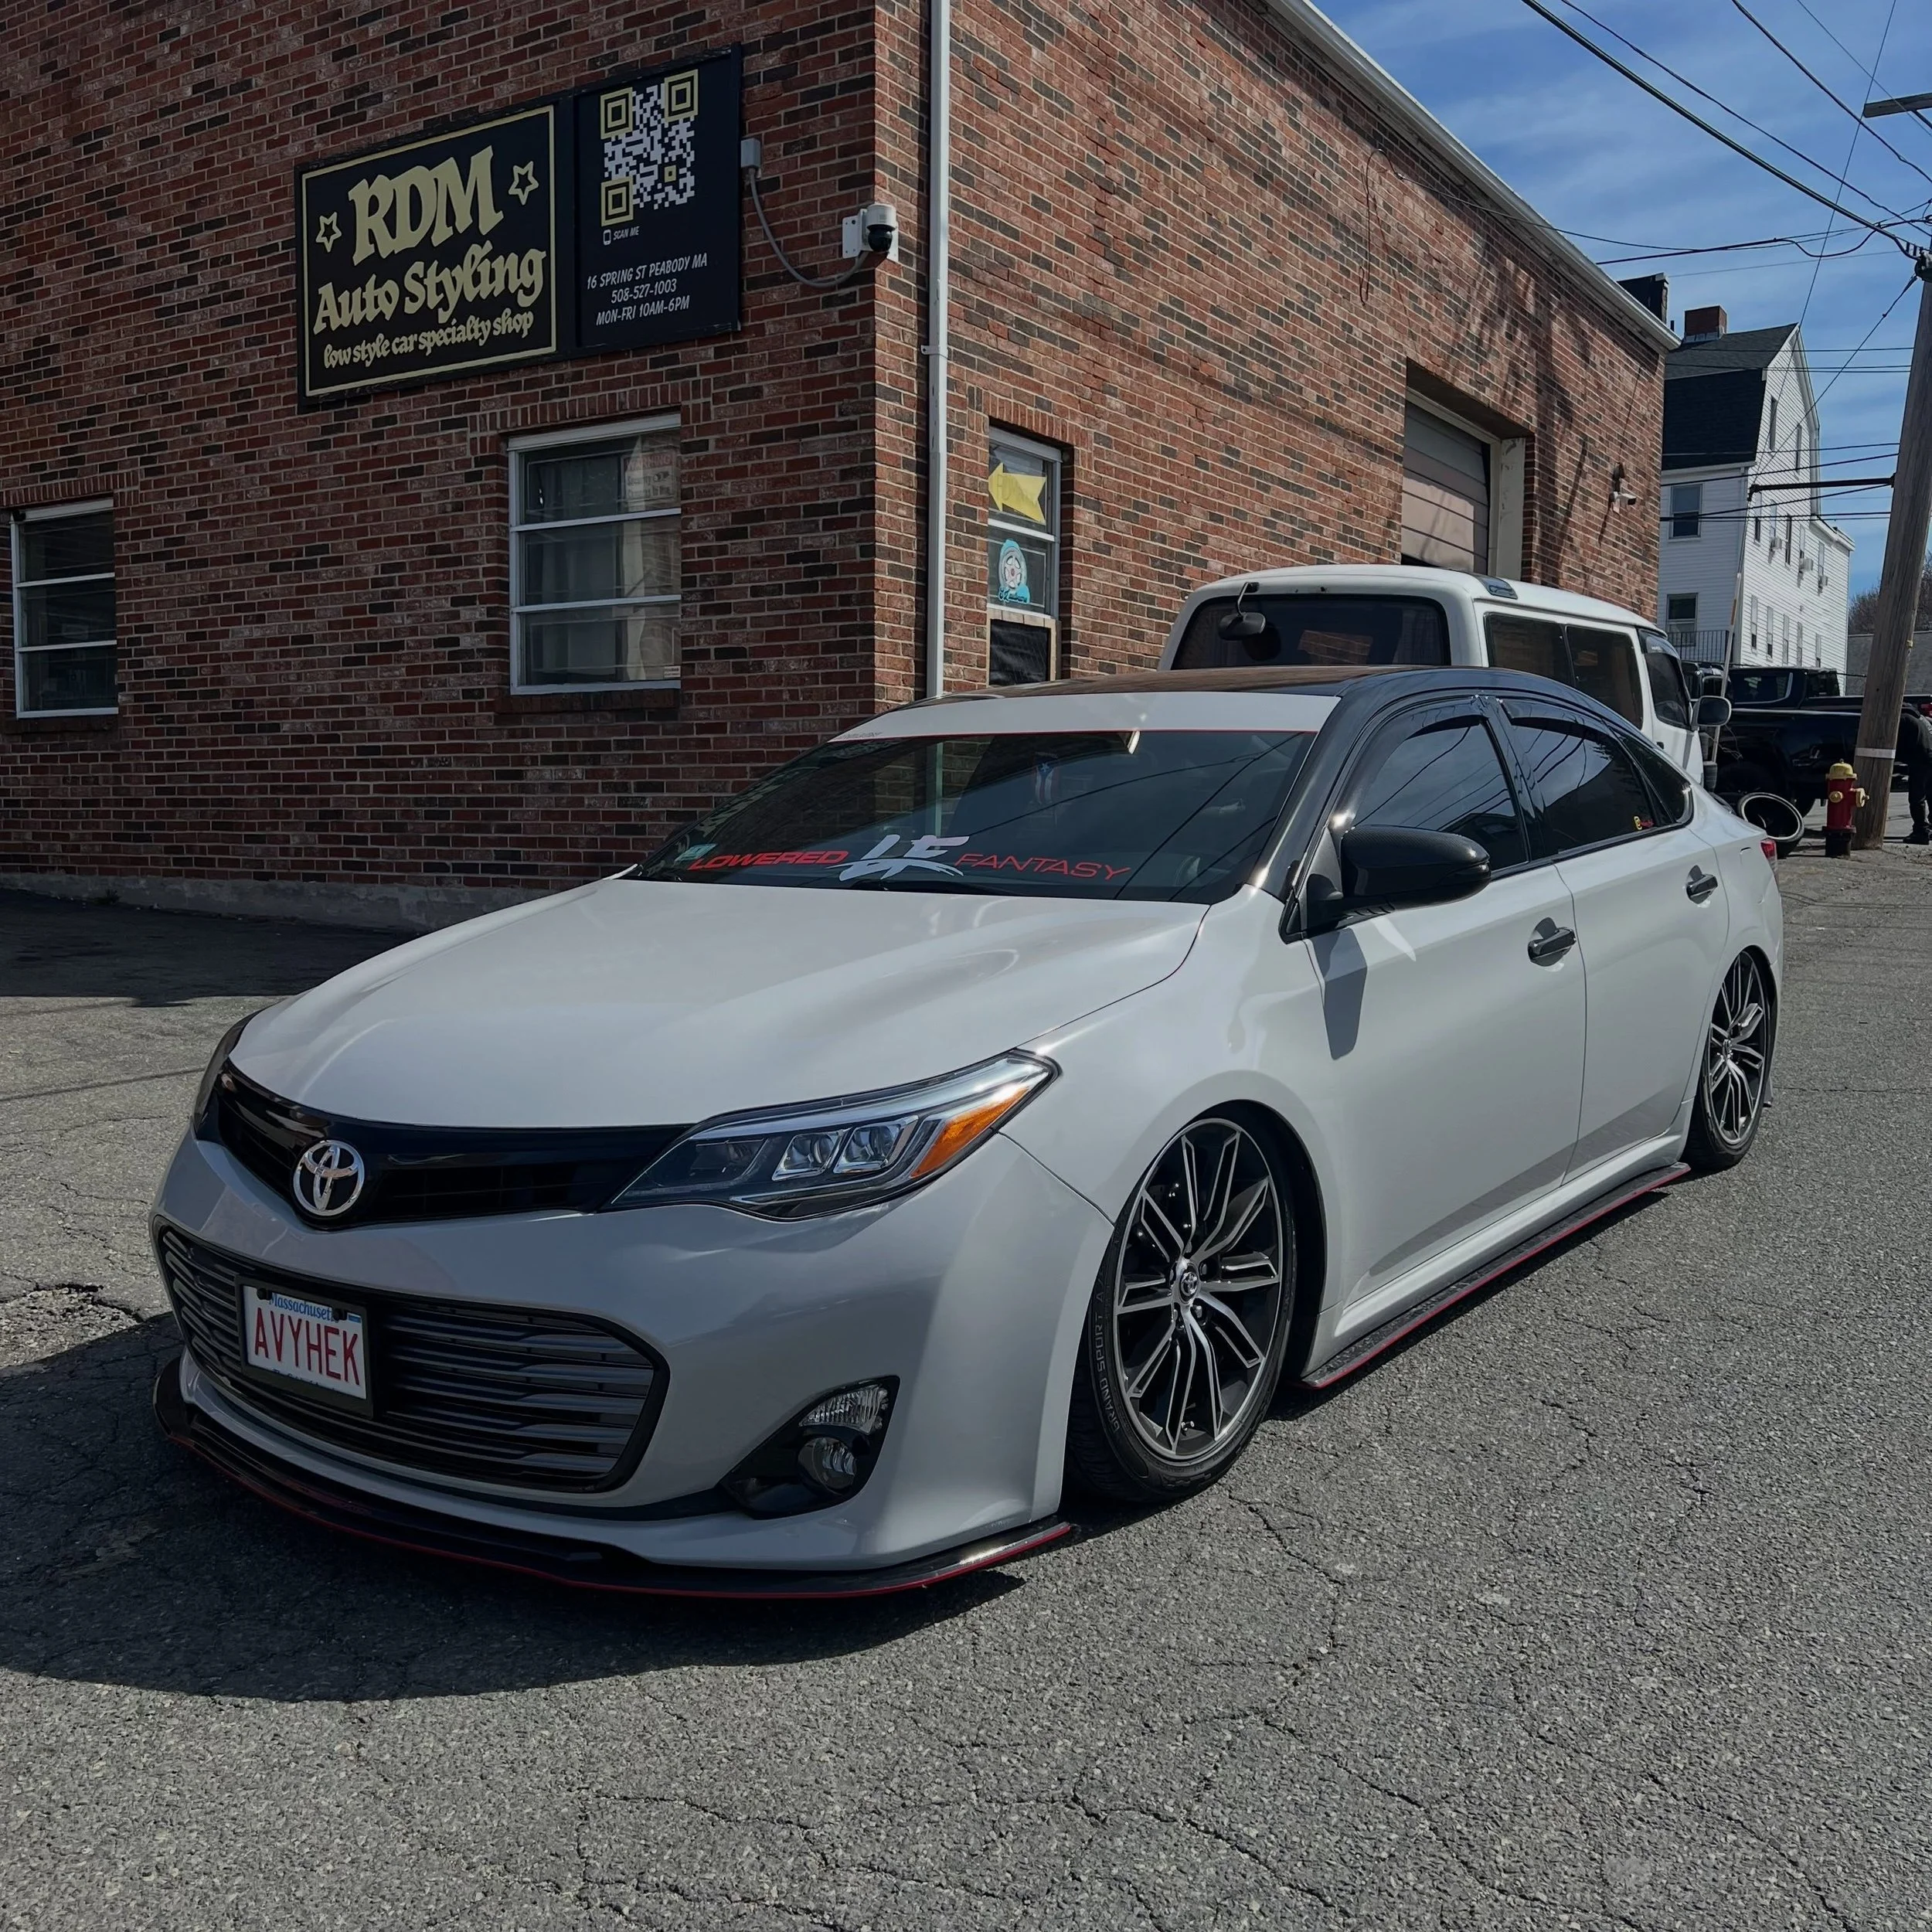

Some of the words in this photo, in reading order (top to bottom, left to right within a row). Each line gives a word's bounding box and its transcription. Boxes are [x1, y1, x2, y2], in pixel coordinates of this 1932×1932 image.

[348, 145, 504, 266] RDM
[613, 229, 628, 240] SCAN
[629, 226, 640, 236] ME
[313, 274, 400, 335] Auto
[403, 240, 546, 324] Styling
[587, 275, 597, 290] 16
[600, 267, 634, 287] SPRING
[635, 264, 647, 280] ST
[649, 256, 690, 277] PEABODY
[692, 253, 707, 269] MA
[611, 278, 677, 304] 508-527-1003
[596, 305, 637, 325] MON-FRI
[639, 295, 690, 318] 10AM-6PM
[324, 344, 352, 369] low
[352, 333, 390, 367] style
[392, 333, 417, 354] car
[418, 315, 492, 356] specialty
[492, 308, 534, 338] shop
[688, 851, 849, 871] LOWERED
[954, 854, 1131, 880] FANTASY
[269, 1293, 338, 1322] Massachuset
[254, 1307, 360, 1386] AVYHEK
[1094, 1313, 1106, 1372] SPORT
[1098, 1378, 1121, 1434] GRAND
